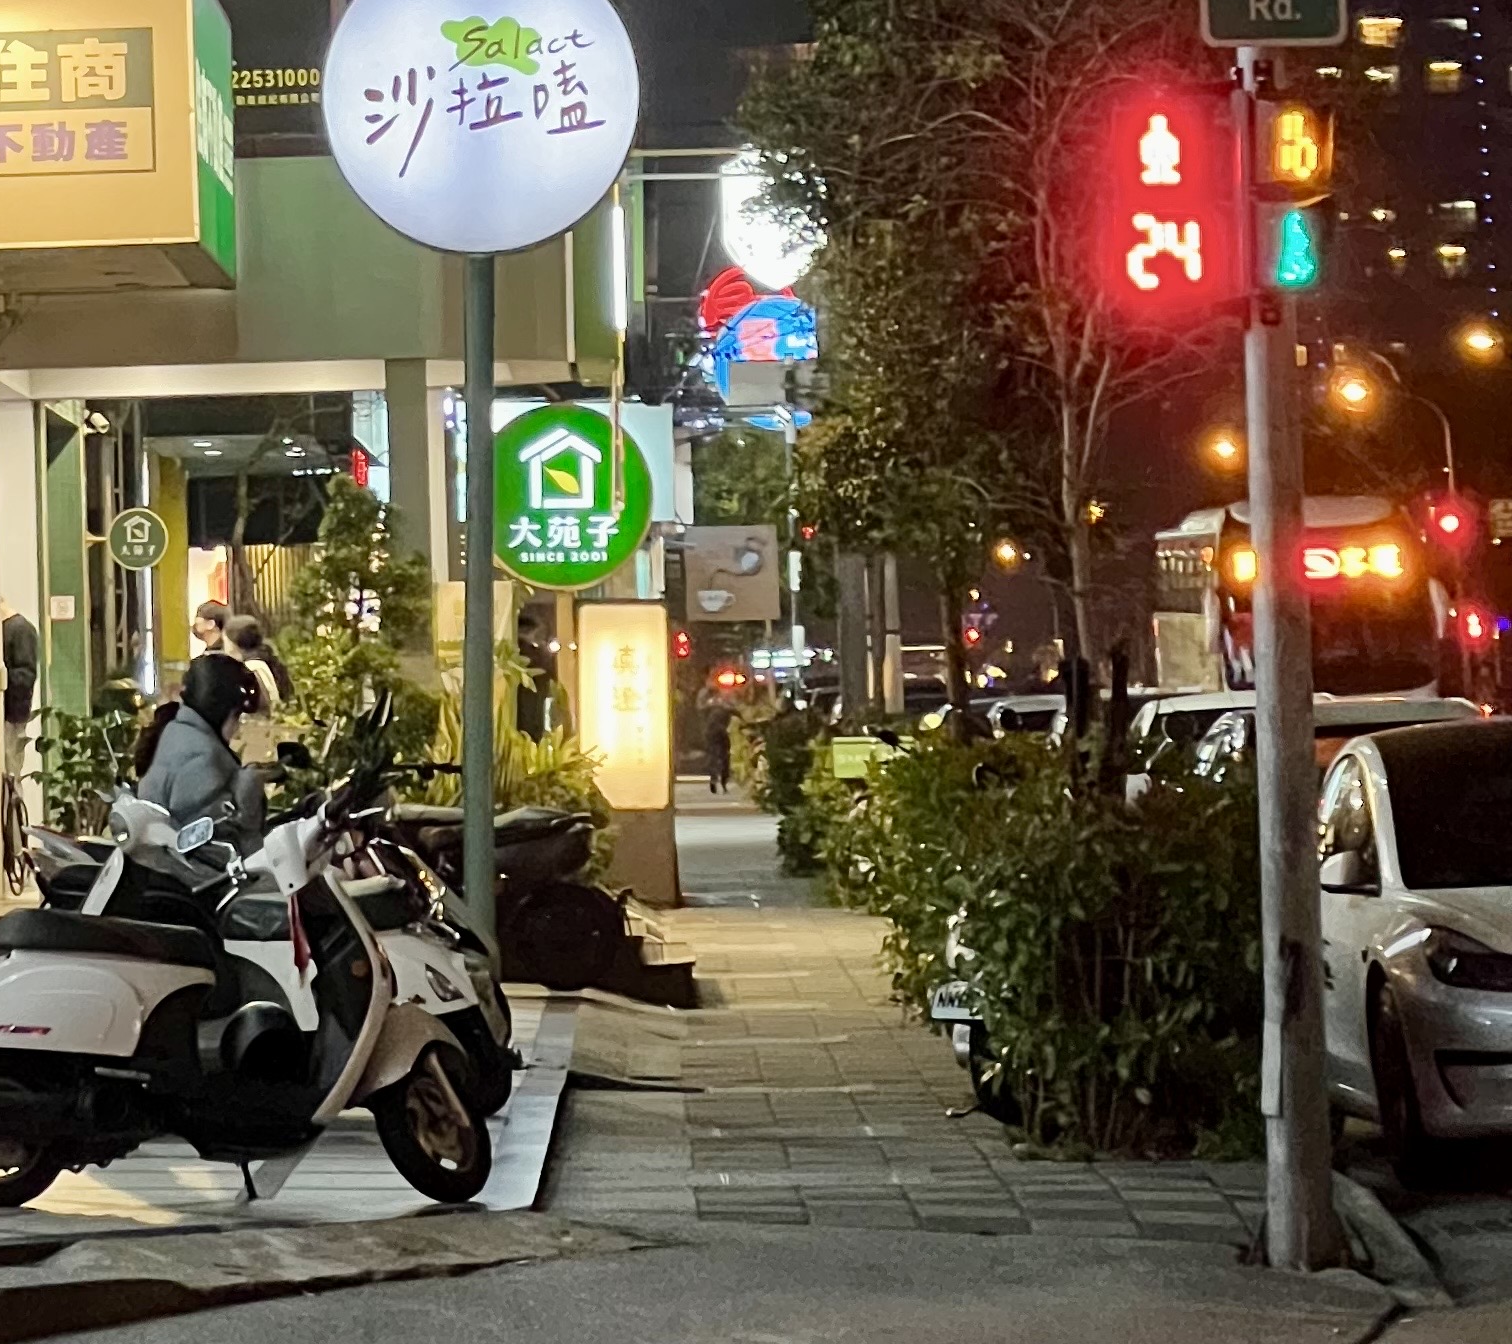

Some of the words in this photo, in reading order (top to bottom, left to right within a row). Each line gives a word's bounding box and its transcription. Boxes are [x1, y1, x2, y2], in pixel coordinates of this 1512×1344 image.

[448, 24, 596, 72] Salact
[363, 59, 607, 179] 沙拉嗑
[1127, 214, 1202, 291] 24
[507, 515, 620, 549] 大苑子
[520, 551, 565, 563] SINCE
